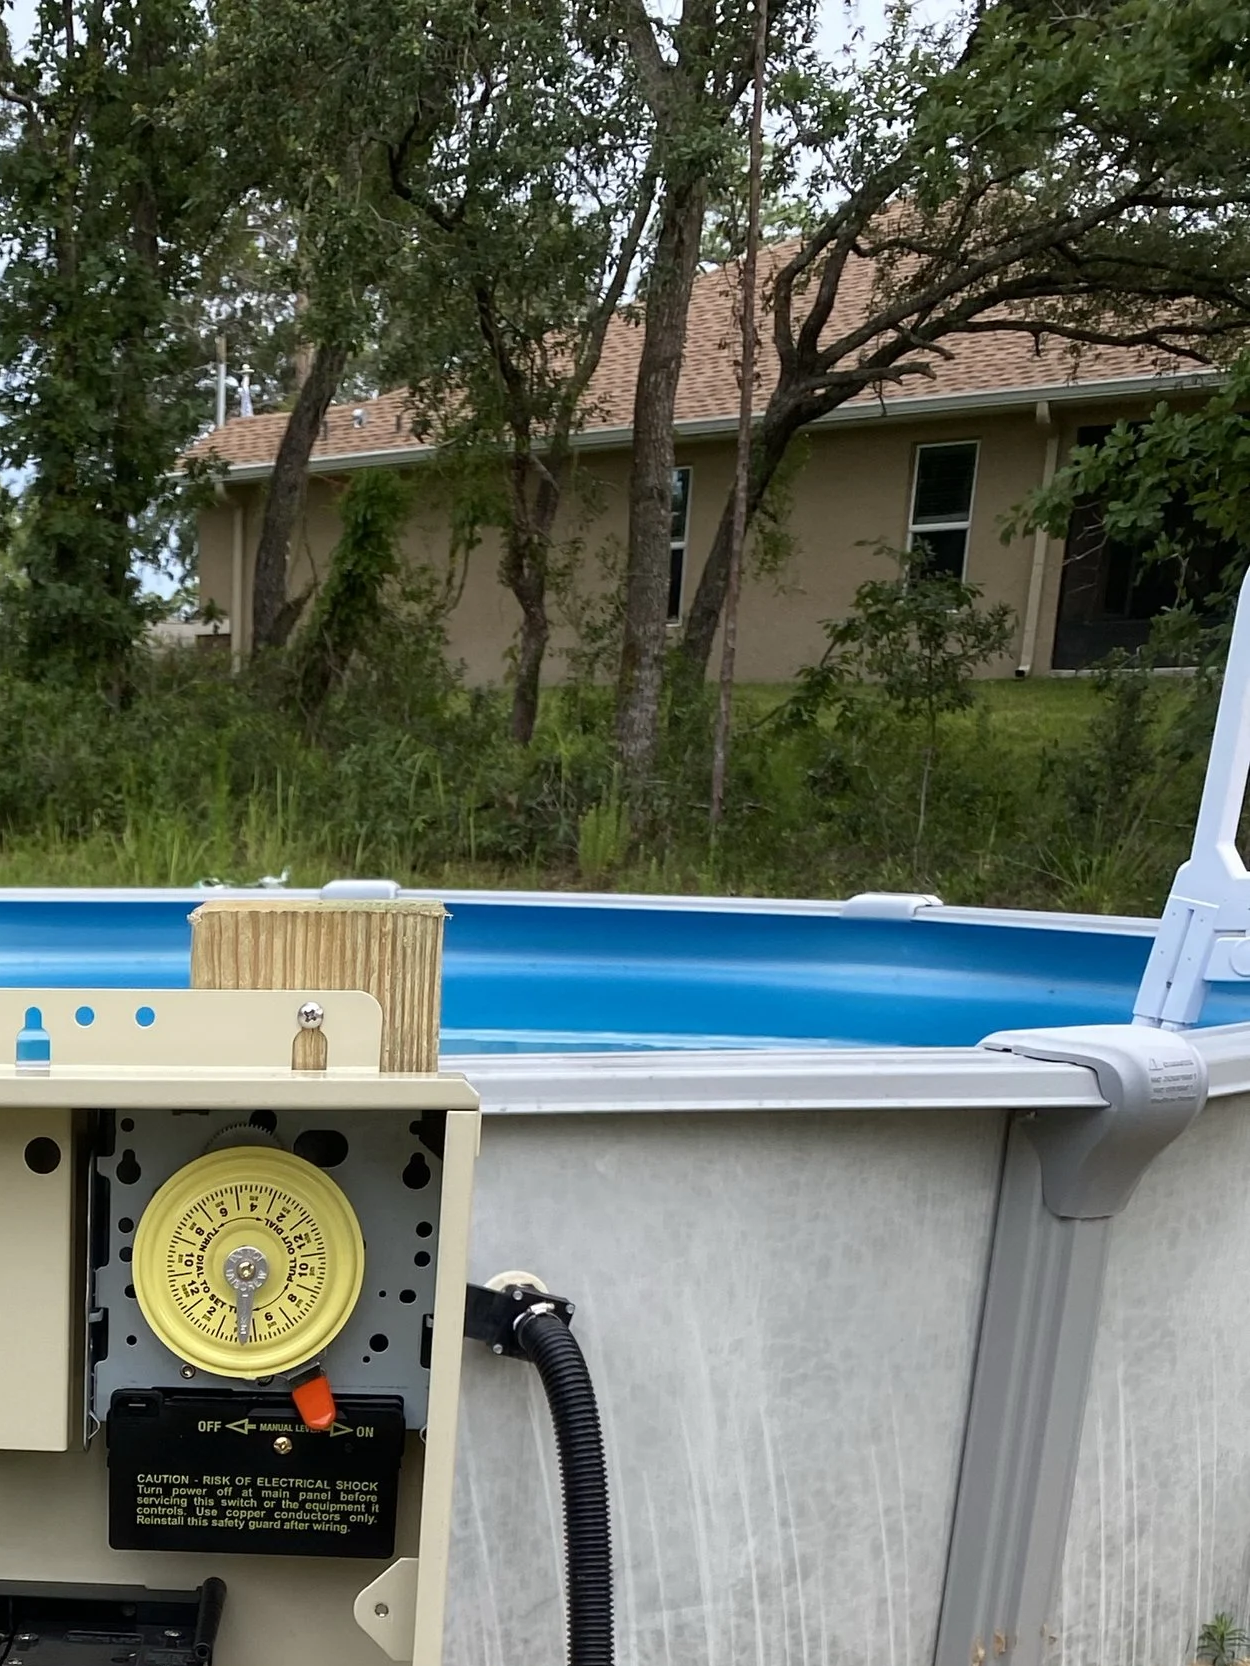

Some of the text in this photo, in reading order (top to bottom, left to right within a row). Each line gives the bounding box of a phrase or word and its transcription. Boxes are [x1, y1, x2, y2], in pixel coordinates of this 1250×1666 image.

[263, 1218, 296, 1282] PULL OUT DIAL
[184, 1252, 193, 1266] 10
[196, 1228, 227, 1308] TURN DIAL TO SET
[187, 1280, 199, 1295] 12
[198, 1421, 222, 1432] OFF
[260, 1423, 293, 1432] MANUAL
[356, 1426, 374, 1437] ON
[137, 1474, 379, 1491] CAUTION RISK OF ELECTRICAL SHOCK
[138, 1485, 377, 1502] Turn power off at main panel before
[137, 1496, 365, 1514] servicing this switch or the equipment
[137, 1506, 377, 1525] controls. Use copper conductors only.
[137, 1516, 350, 1534] Reinstall this safety guard after wiring.
